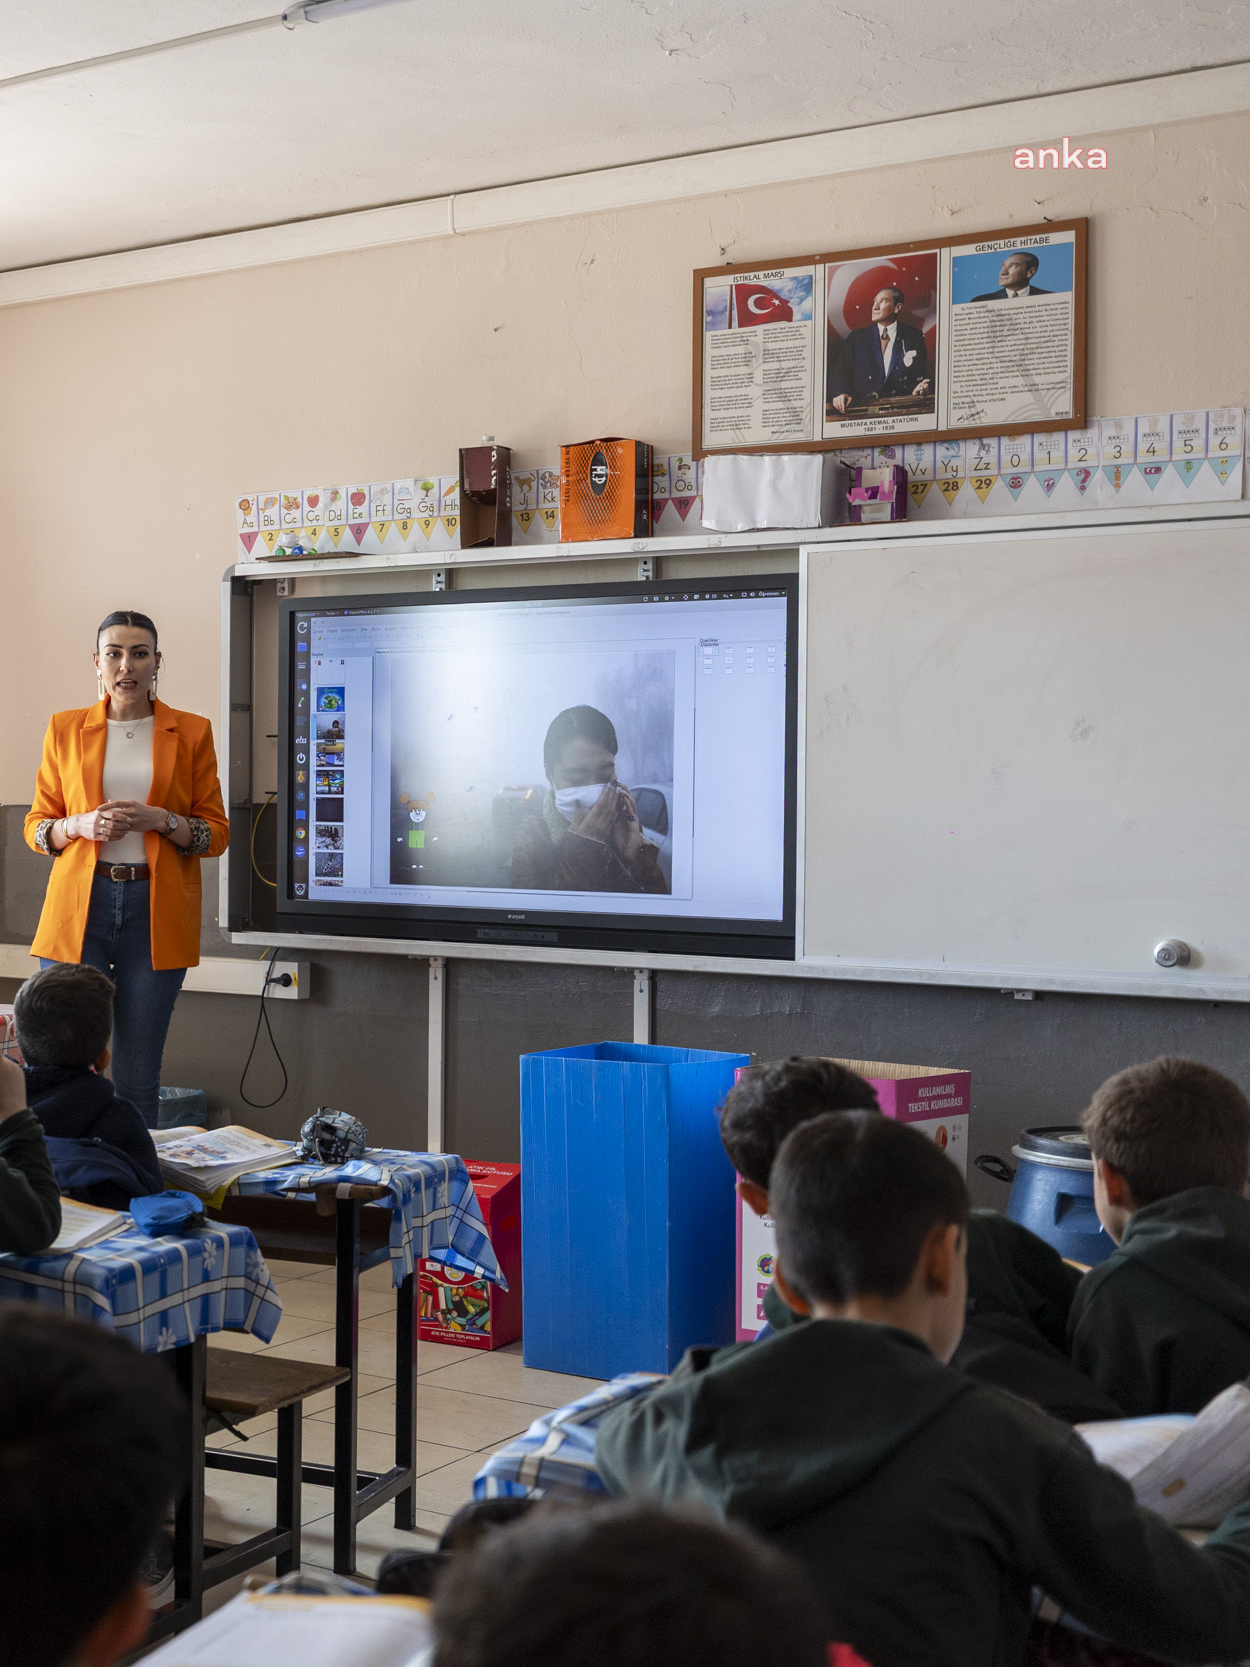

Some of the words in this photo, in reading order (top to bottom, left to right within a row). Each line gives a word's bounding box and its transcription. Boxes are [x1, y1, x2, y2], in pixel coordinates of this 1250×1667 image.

[975, 240, 1018, 252] GENÇLİĞE
[1020, 236, 1050, 246] HİTABE
[733, 274, 761, 282] İSTİKLAL
[763, 270, 784, 279] MARŞI
[908, 462, 927, 476] Vv
[941, 460, 958, 478] Yy
[974, 457, 990, 471] Zz
[1011, 454, 1020, 468] 0
[1047, 452, 1051, 465] 1
[1078, 448, 1088, 462] 2
[1114, 445, 1122, 459] 3
[1146, 442, 1157, 456] 4
[1184, 439, 1194, 454] 5
[1219, 437, 1228, 450] 6
[675, 476, 693, 492] Öö
[911, 484, 928, 495] 27
[943, 481, 959, 492] 28
[975, 479, 992, 489] 29
[519, 493, 528, 510] Jj
[543, 491, 556, 503] Kk
[678, 500, 689, 509] 19
[242, 518, 254, 528] Aa
[264, 515, 274, 526] Bb
[283, 513, 297, 524] Cc
[306, 510, 320, 524] Çç
[328, 509, 342, 522] Dd
[352, 508, 363, 519] Ee
[376, 504, 386, 516] Ff
[396, 503, 412, 518] Gg
[418, 498, 434, 517] Ğğ
[444, 499, 459, 511] Hh
[520, 512, 530, 521] 13
[545, 510, 555, 520] 14
[268, 532, 274, 541] 2
[334, 528, 340, 536] 5
[356, 526, 362, 534] 6
[379, 523, 385, 532] 7
[402, 521, 408, 530] 8
[424, 520, 430, 528] 9
[446, 518, 456, 527] 10
[918, 1084, 955, 1098] KULLANILMIŞ
[908, 1099, 930, 1113] TEKSTİL
[931, 1097, 963, 1110] KUMBARASI
